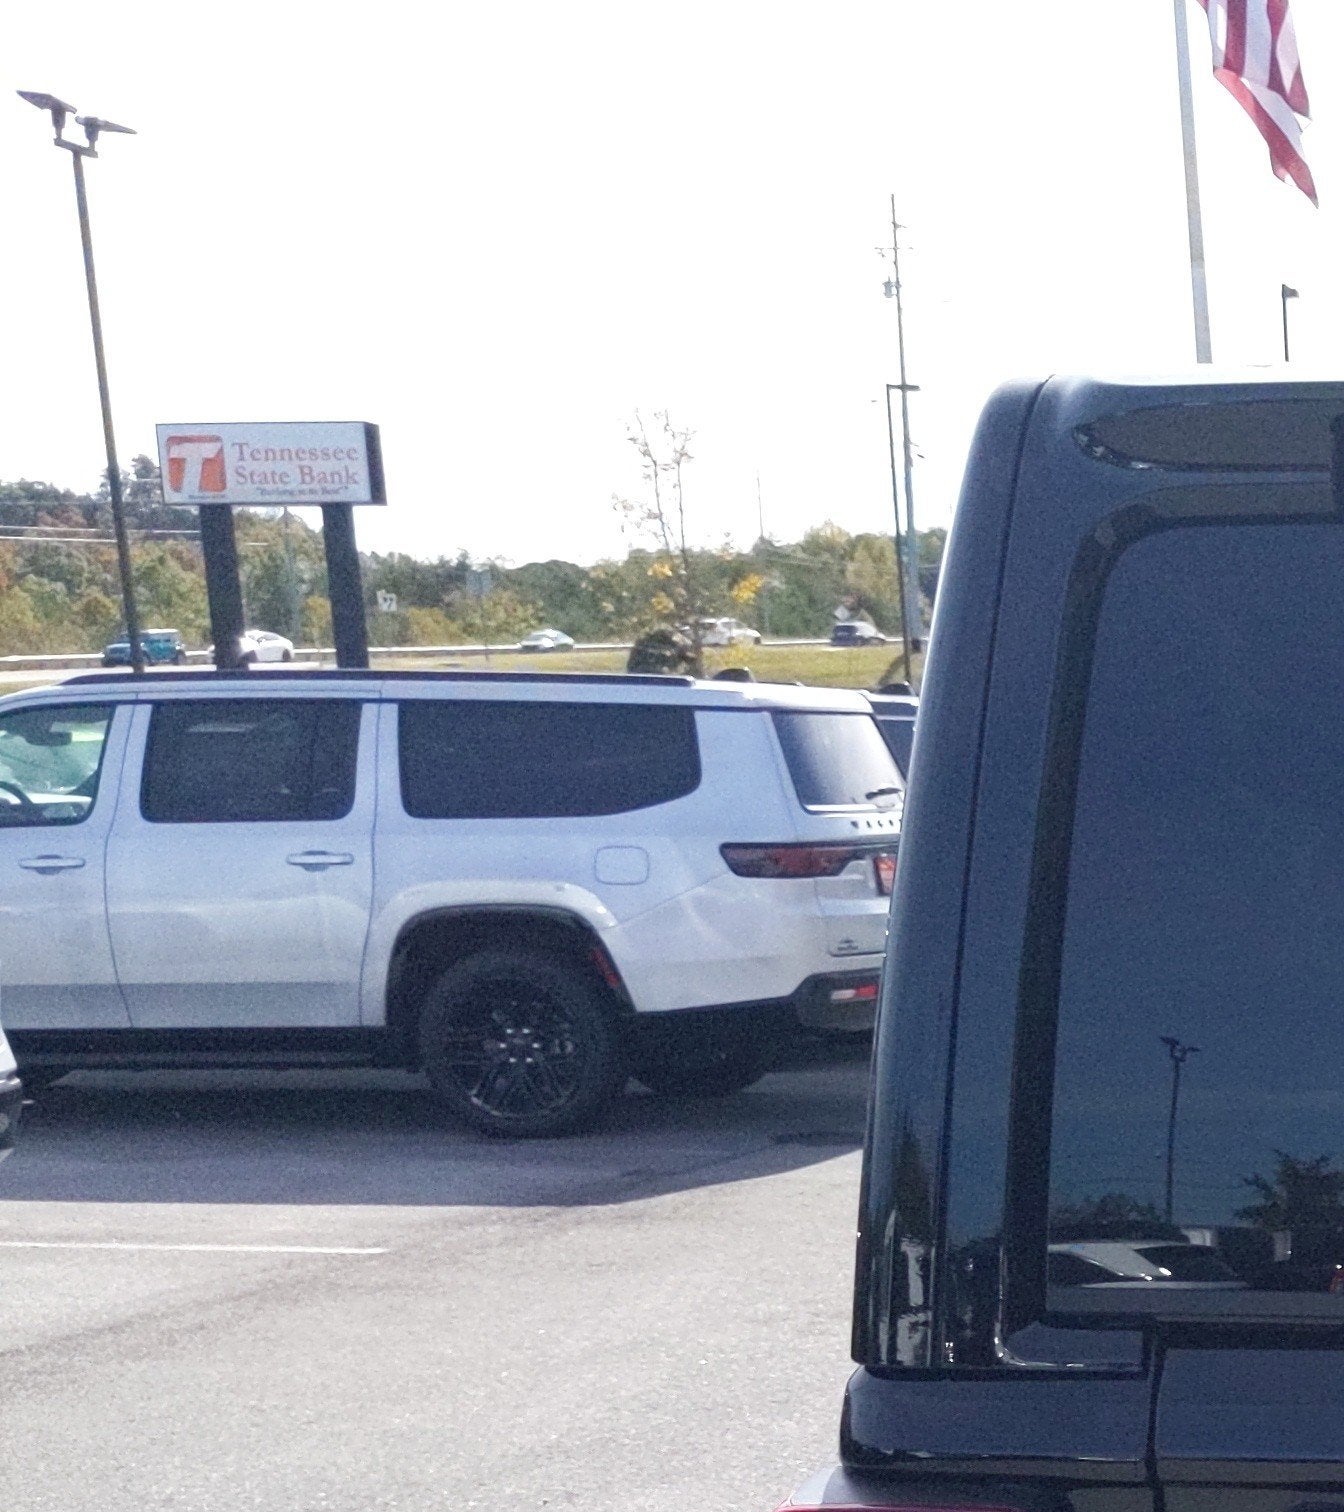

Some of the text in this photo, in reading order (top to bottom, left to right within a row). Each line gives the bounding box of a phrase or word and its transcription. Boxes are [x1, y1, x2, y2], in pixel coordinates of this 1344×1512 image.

[232, 442, 360, 462] Tennessee
[234, 465, 360, 486] State Bank
